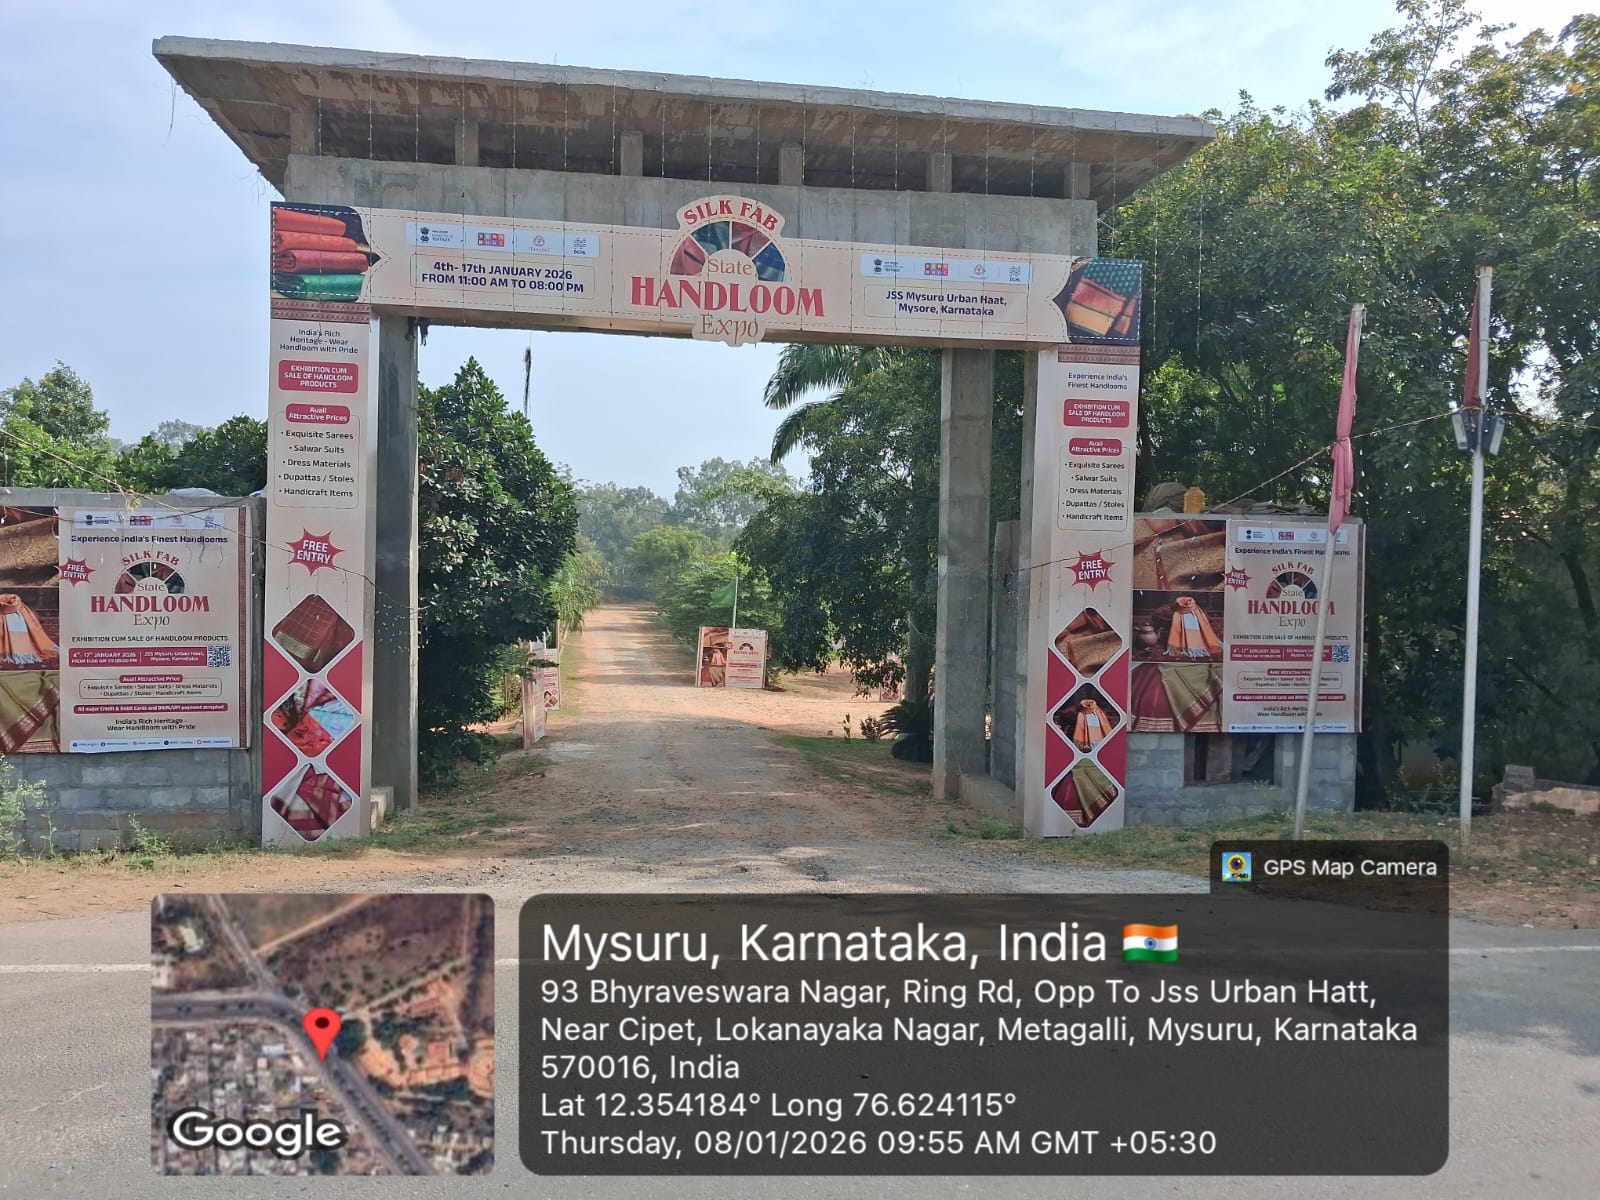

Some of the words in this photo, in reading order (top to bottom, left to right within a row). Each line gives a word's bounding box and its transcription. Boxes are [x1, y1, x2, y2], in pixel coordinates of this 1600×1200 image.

[683, 199, 733, 225] SILK
[739, 202, 778, 232] FAB
[461, 263, 486, 274] 17th
[488, 265, 540, 278] JANUARY
[544, 269, 573, 280] 2026
[708, 258, 751, 275] State
[422, 273, 455, 284] FROM
[458, 275, 487, 286] 11:00
[489, 277, 508, 288] AM
[511, 279, 526, 289] TO
[529, 280, 564, 291] 08:00
[566, 282, 584, 293] PM
[631, 276, 824, 317] HANDLOOM
[886, 290, 903, 300] JSS
[906, 292, 945, 303] Mysuru
[947, 293, 978, 303] Urban
[980, 295, 1007, 306] Haat,
[898, 303, 939, 315] Mysore,
[941, 305, 994, 316] Karnataka
[700, 314, 759, 346] Expo
[290, 336, 322, 345] Heritage
[280, 344, 318, 352] Handloom
[290, 365, 330, 373] EXHIBITION
[1068, 372, 1105, 380] Experience
[300, 380, 337, 388] PRODUCTS
[285, 429, 324, 440] Exquisite
[325, 431, 354, 439] Sarees
[294, 444, 322, 453] Salwar
[312, 460, 351, 468] Materials
[1068, 461, 1100, 470] Exquisite
[283, 473, 321, 482] Dupattas
[329, 475, 354, 483] Stoles
[1075, 474, 1098, 482] Salwar
[284, 488, 327, 496] Handicraft
[1066, 500, 1097, 508] Dupattas
[71, 535, 120, 544] Experience
[151, 535, 178, 543] Finest
[180, 535, 228, 543] Handlooms
[302, 539, 328, 552] FREE
[296, 549, 331, 564] ENTRY
[1234, 547, 1271, 556] Experience
[1294, 548, 1314, 556] Finest
[121, 550, 152, 566] SILK
[156, 550, 180, 566] FAB
[67, 563, 85, 572] FREE
[1081, 559, 1103, 570] FREE
[1272, 561, 1294, 575] SILK
[63, 570, 87, 580] ENTRY
[1078, 569, 1106, 580] ENTRY
[136, 582, 165, 592] State
[90, 595, 209, 613] HANDLOOM
[133, 614, 170, 630] Expo
